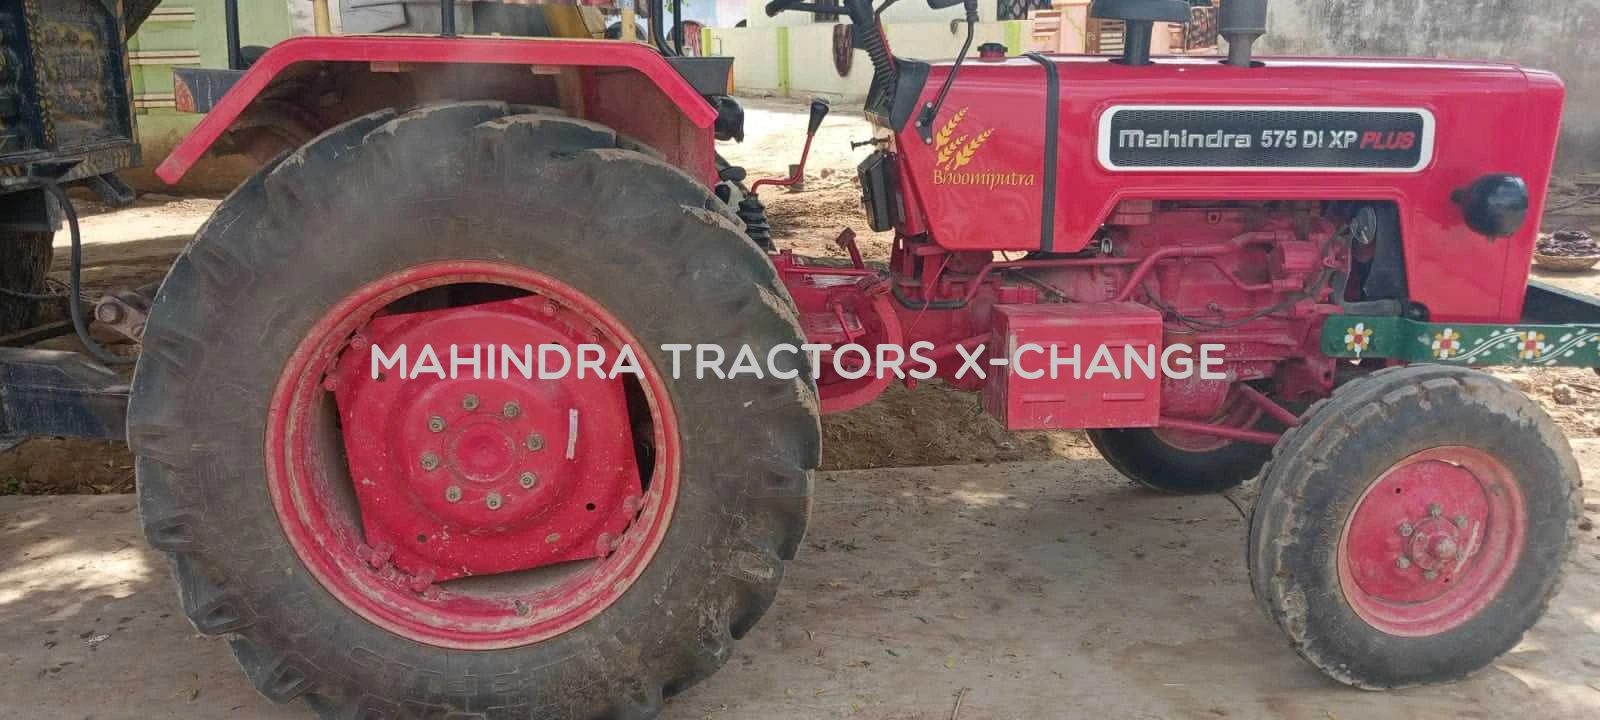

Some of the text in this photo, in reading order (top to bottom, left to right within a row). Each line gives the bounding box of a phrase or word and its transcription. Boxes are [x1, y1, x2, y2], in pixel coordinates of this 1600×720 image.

[1119, 129, 1415, 149] Mahindra 575 DI XP PLUS
[934, 169, 1035, 190] Bhoomiputra
